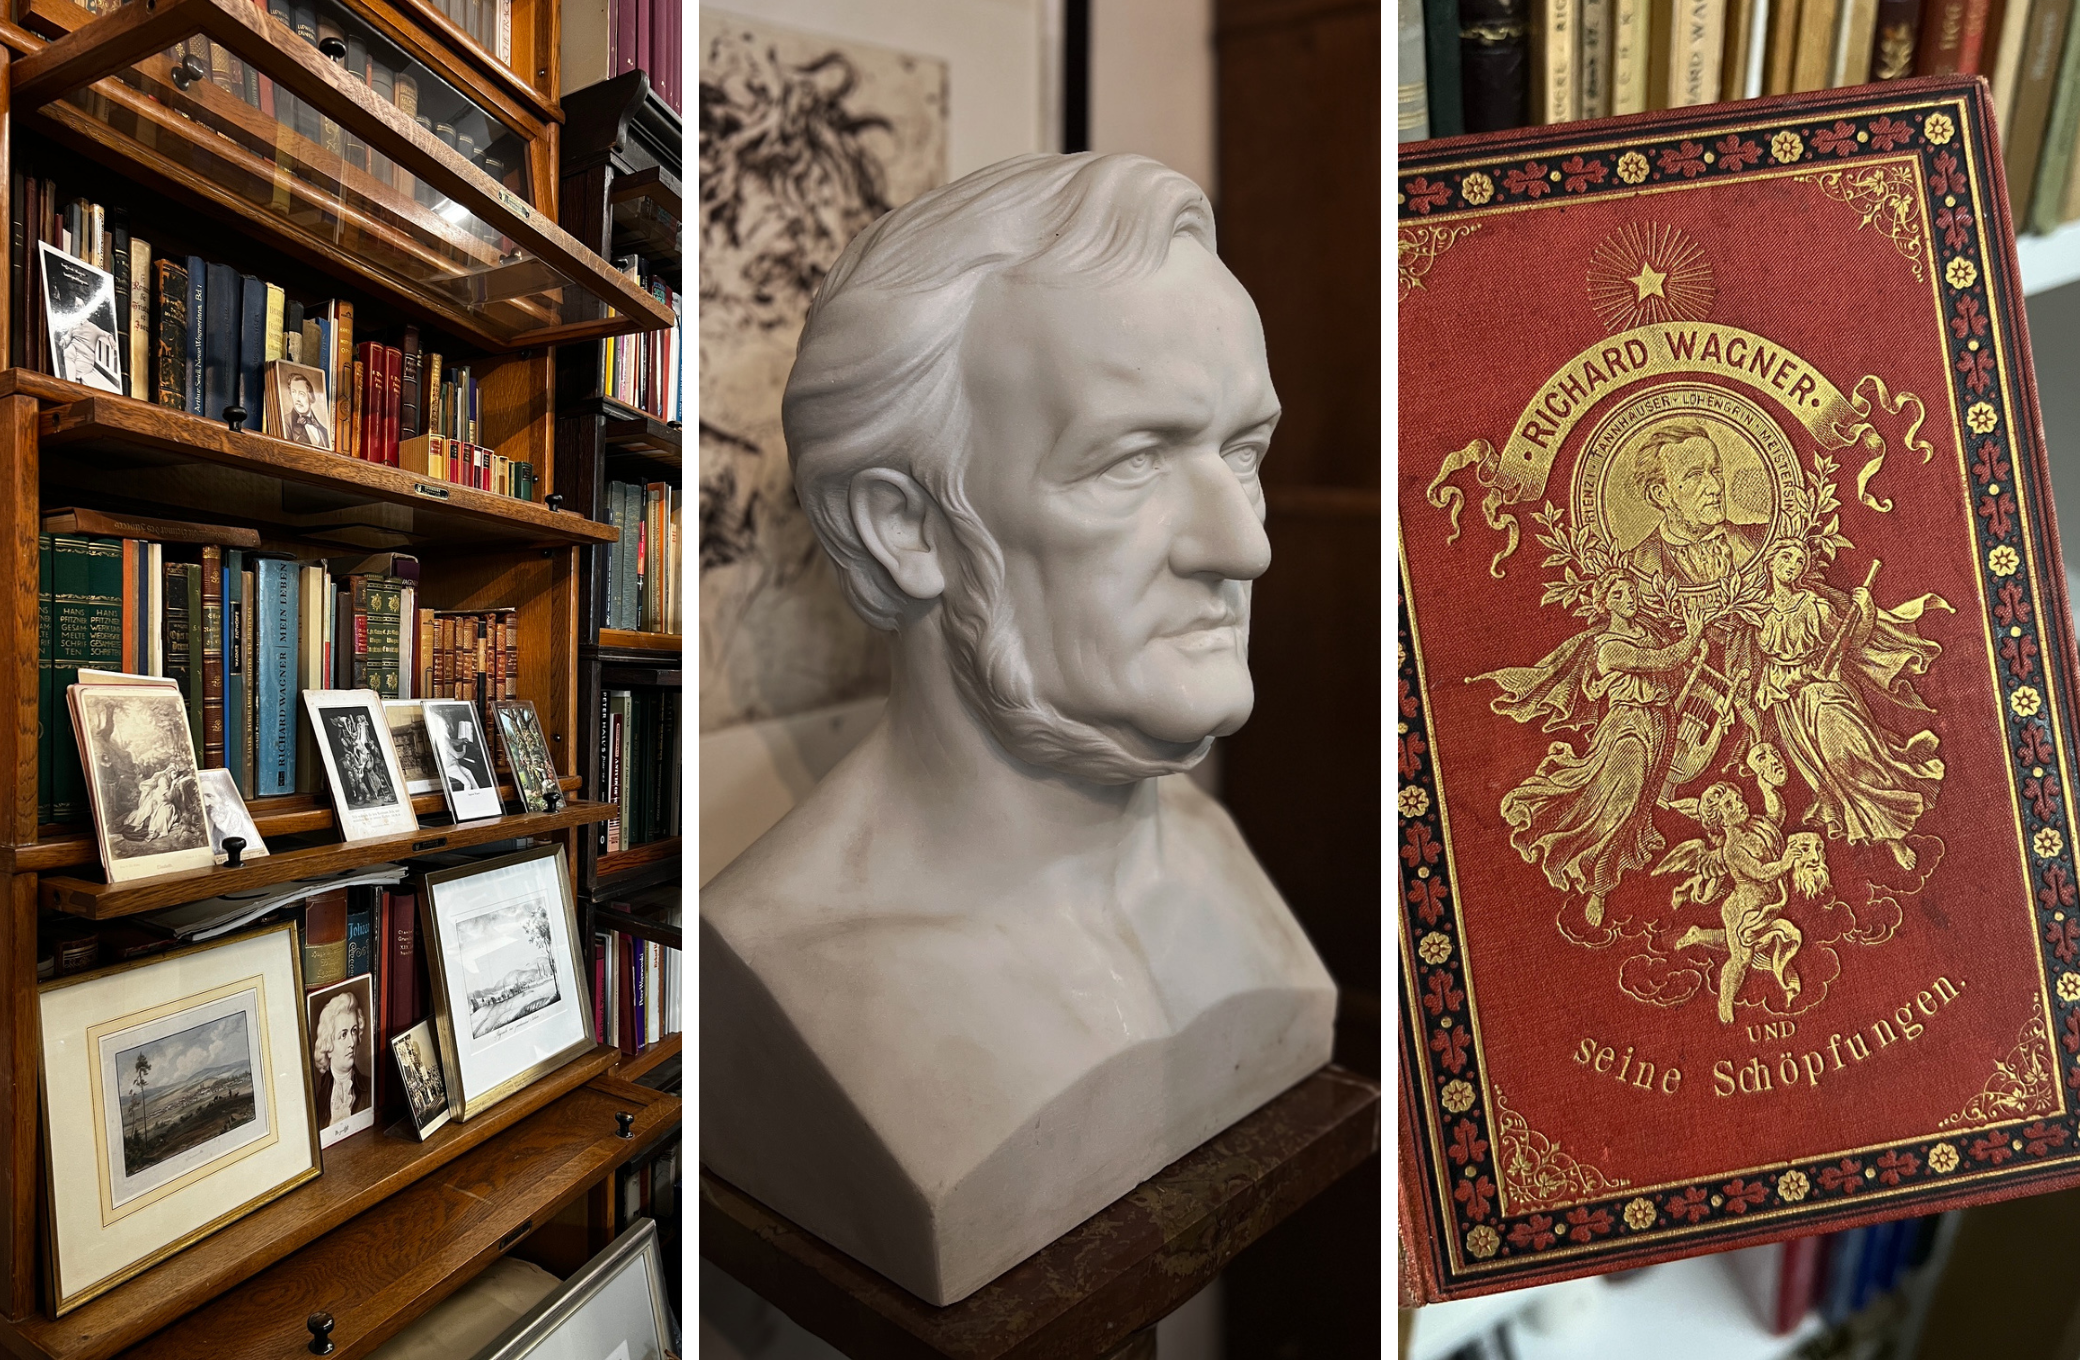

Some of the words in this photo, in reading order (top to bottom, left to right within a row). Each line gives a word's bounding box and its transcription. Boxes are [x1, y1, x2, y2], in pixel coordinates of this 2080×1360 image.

[1521, 338, 1649, 450] RICHARD
[1665, 330, 1821, 409] WAGNER
[1583, 473, 1597, 523] RIENZI
[1682, 394, 1754, 425] LOHENGRIN
[1760, 429, 1795, 514] MEISTERSIN
[63, 608, 85, 616] HANS
[96, 609, 118, 618] HANS
[280, 612, 288, 642] MEIN
[65, 648, 82, 656] TEN
[278, 710, 286, 766] RICHARD
[1574, 1037, 1682, 1094] seine
[1712, 975, 1968, 1098] Schöpfungen.
[1748, 1020, 1797, 1043] UND
